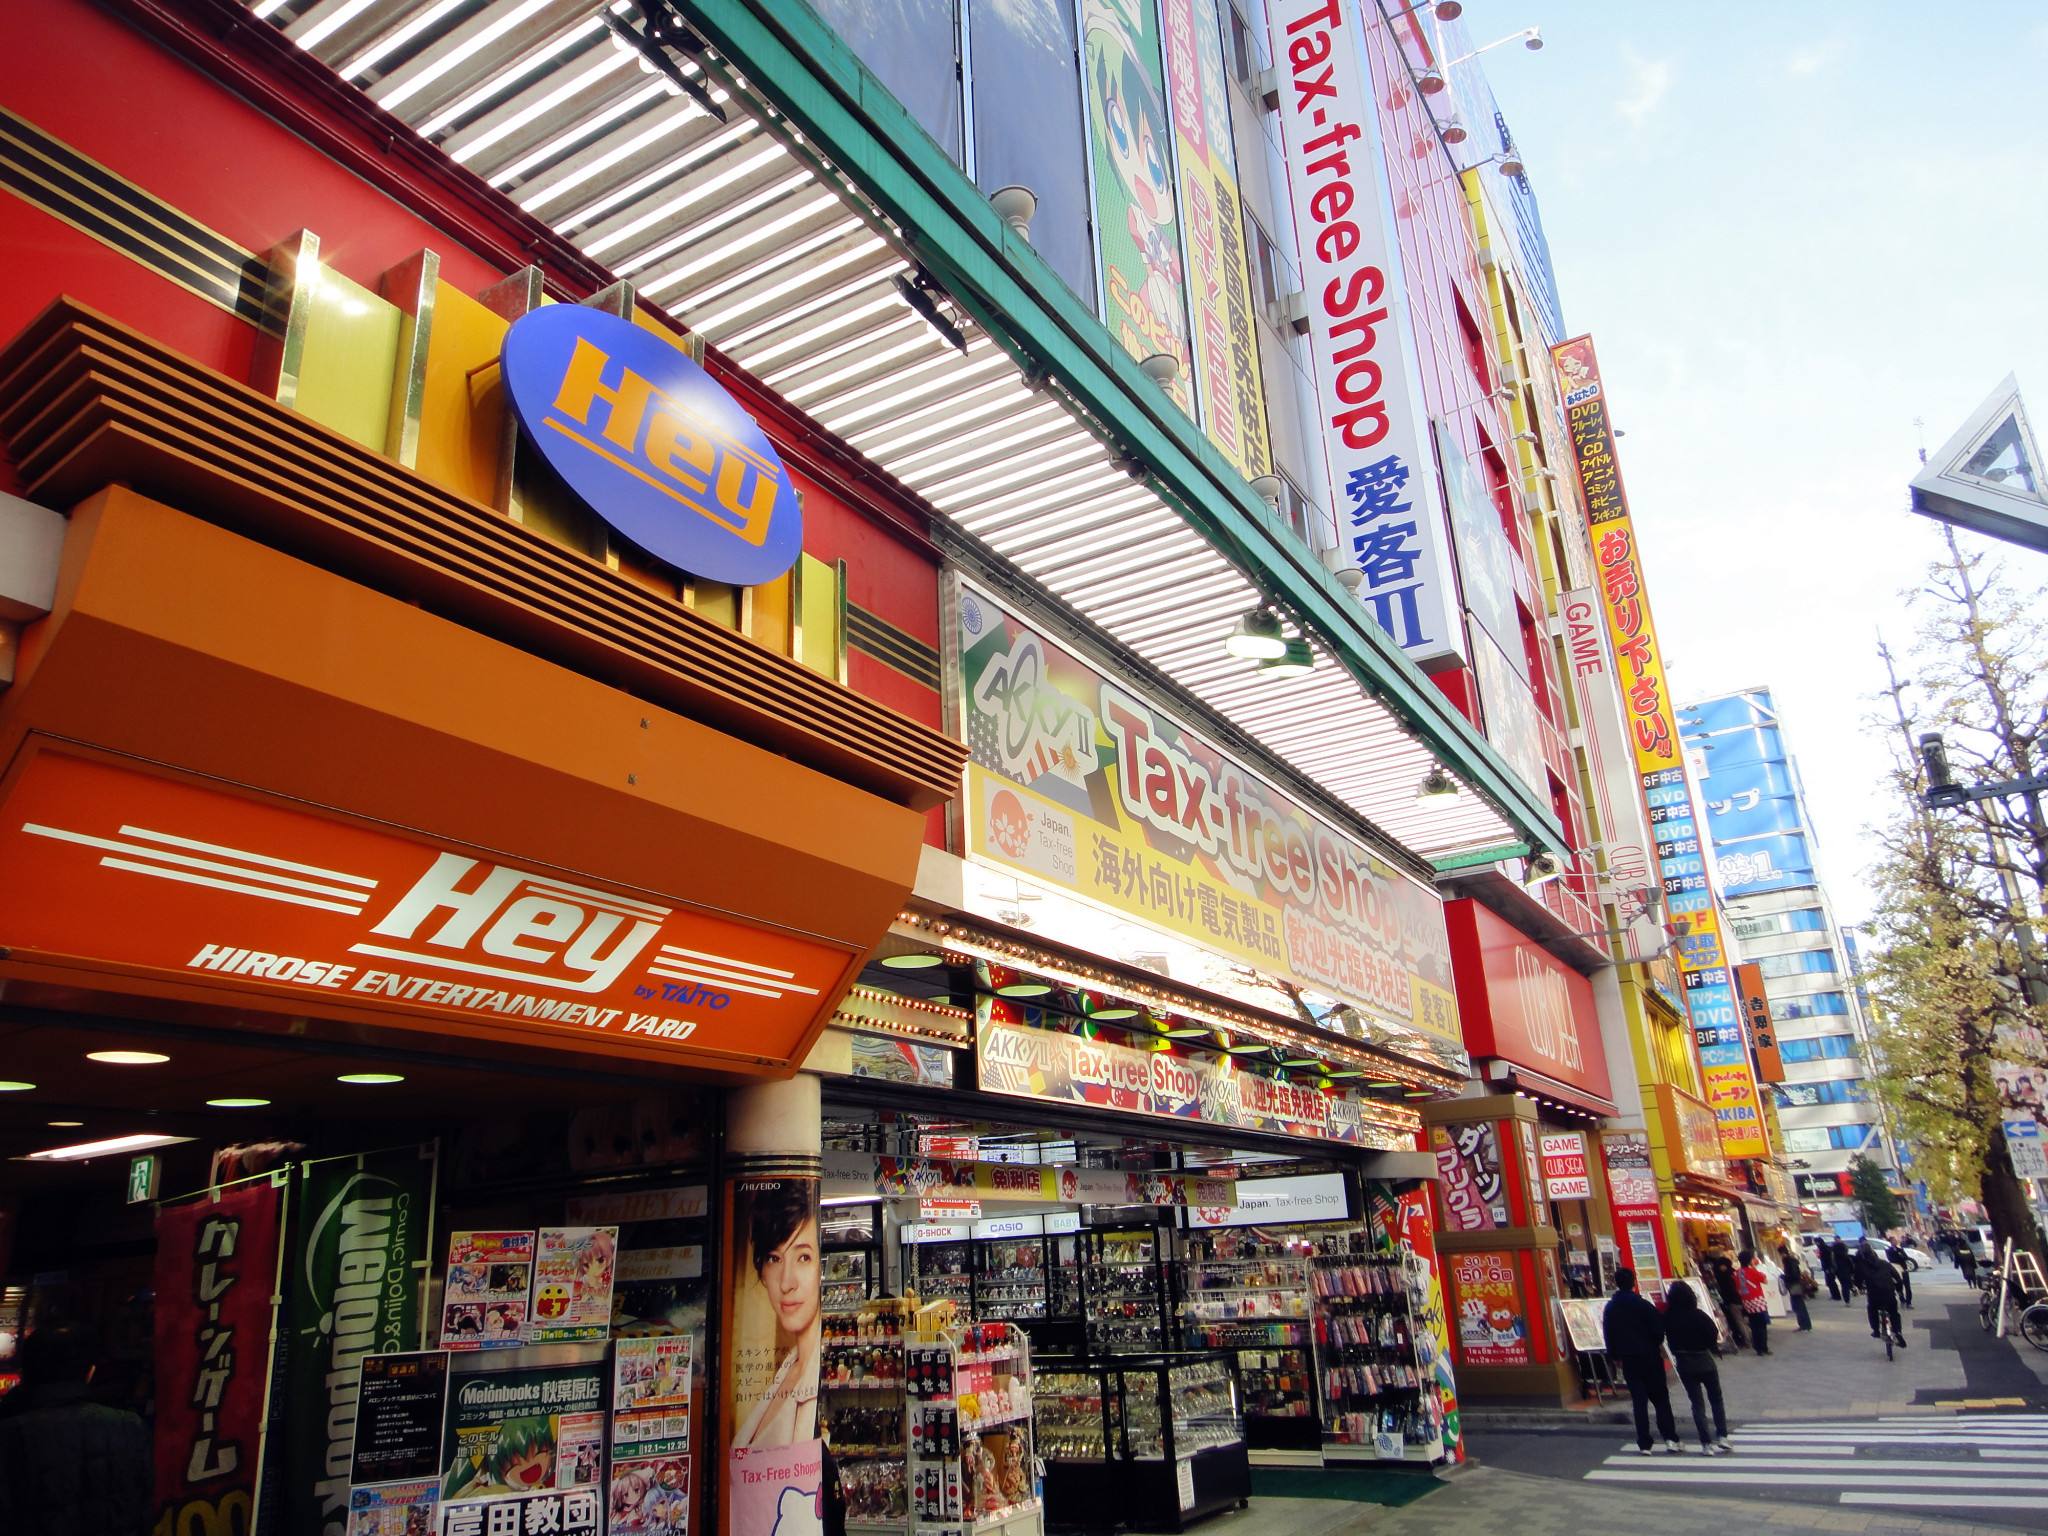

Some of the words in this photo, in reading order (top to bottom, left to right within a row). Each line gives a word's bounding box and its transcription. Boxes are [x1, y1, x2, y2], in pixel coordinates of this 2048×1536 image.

[1286, 0, 1361, 264] Tax-free
[1188, 168, 1222, 312] DUTY
[1323, 265, 1390, 452] Shop
[1201, 299, 1239, 456] FREE
[1567, 384, 1598, 406] あなたの
[1571, 401, 1600, 420] DVD
[1572, 413, 1604, 432] ブルーレイ
[546, 334, 781, 548] Hey
[1575, 427, 1607, 445] ゲーム
[1583, 441, 1604, 456] CD
[1580, 453, 1611, 470] アイドル
[1583, 466, 1615, 484] アニメ
[1587, 479, 1616, 495] コミック
[1591, 495, 1619, 509] ホビー
[1592, 506, 1622, 522] フィギュア
[1565, 601, 1603, 679] GAME
[1650, 790, 1685, 806] DVD
[1107, 698, 1312, 891] Tax-free
[1317, 832, 1401, 944] Shop
[1657, 825, 1693, 840] DVD
[1037, 831, 1074, 857] Tax-free
[1051, 854, 1075, 878] Shop
[1665, 861, 1700, 876] DVD
[1091, 831, 1282, 962] 海外向け電気製品
[1671, 898, 1709, 914] DVD
[368, 851, 673, 994] Hey
[187, 943, 358, 994] HIROSE
[351, 969, 622, 1029] ENTERTAINMENT
[621, 1011, 697, 1040] YARD
[633, 983, 654, 1001] by
[1695, 1007, 1734, 1025] DVD
[1751, 996, 1773, 1049] 吉野家
[1067, 1041, 1149, 1087] Tax-free
[1153, 1058, 1196, 1098] Shop
[1711, 1087, 1750, 1101] ムーラン
[1715, 1106, 1755, 1121] AKIBA
[1543, 1137, 1581, 1152] GAME
[1606, 1143, 1646, 1155] ダーツコーナー
[1456, 1122, 1500, 1201] ダーツ
[1546, 1157, 1565, 1175] CLUB
[1565, 1158, 1585, 1174] SEGA
[852, 1170, 869, 1182] Shop
[991, 1167, 1041, 1193] 免税店
[738, 1182, 781, 1192] SHISEIDO
[1435, 1147, 1482, 1230] プリクラ
[1550, 1180, 1588, 1195] GAME
[1613, 1179, 1655, 1196] プリクラ
[1239, 1198, 1271, 1211] Japan.
[1275, 1195, 1312, 1208] Tax-free
[1314, 1194, 1339, 1207] Shop
[1620, 1192, 1649, 1203] コーナー
[1617, 1208, 1658, 1217] INFORMATION
[917, 1227, 952, 1238] G-SHOCK
[990, 1222, 1024, 1233] CASIO
[1460, 1282, 1513, 1297] あそべる!
[537, 1297, 570, 1316] 終了
[186, 1217, 239, 1482] クレーンゲーム
[735, 1375, 781, 1388] スピードに
[463, 1383, 541, 1406] Melonbooks
[541, 1376, 601, 1404] 秋葉原店
[457, 1432, 499, 1446] このビル
[456, 1443, 499, 1458] 地下1階
[741, 1463, 791, 1485] Tax-Free
[448, 1493, 599, 1536] 岸田教団
